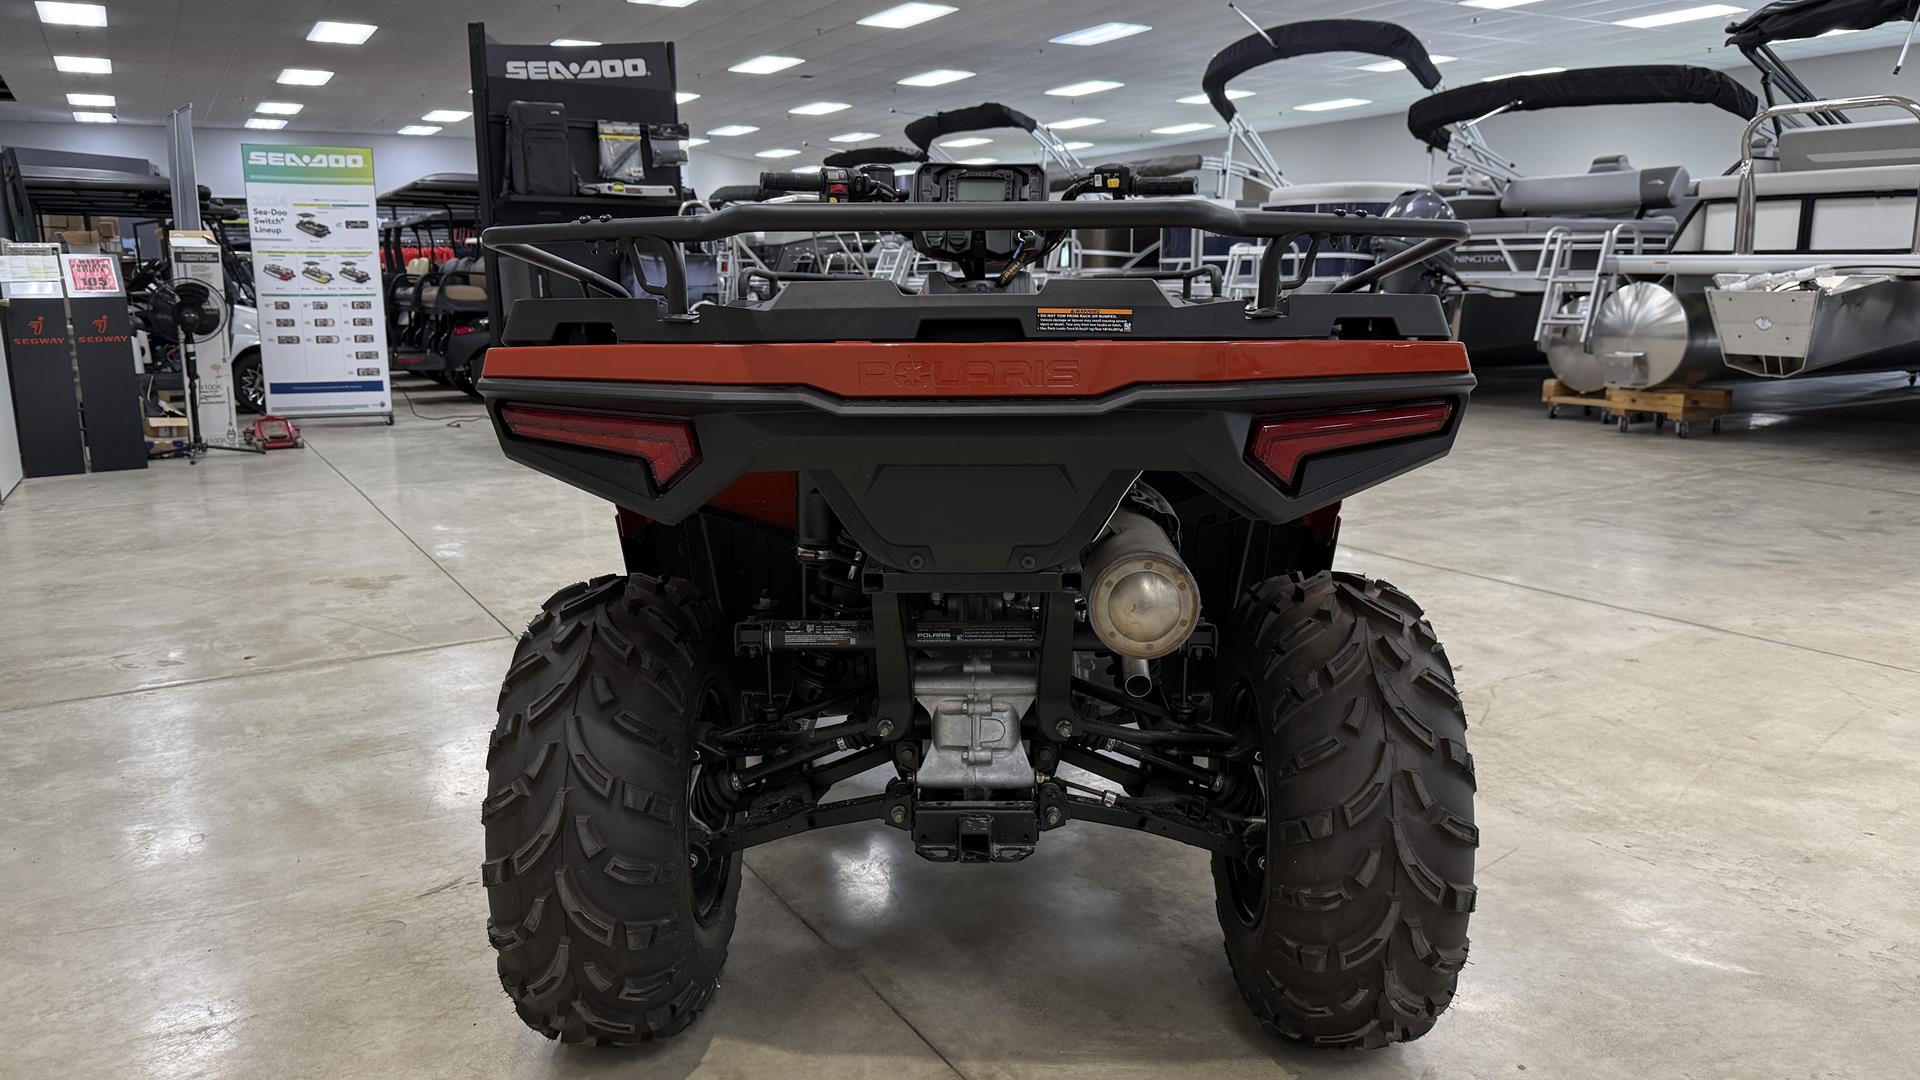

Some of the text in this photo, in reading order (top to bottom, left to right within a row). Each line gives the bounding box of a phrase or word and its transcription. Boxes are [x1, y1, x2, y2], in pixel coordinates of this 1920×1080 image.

[253, 208, 287, 216] Sea-Doo
[255, 226, 282, 235] Lineup
[14, 337, 65, 345] SEGWAY
[79, 336, 128, 344] SEGWAY
[858, 359, 1081, 388] POLARIS
